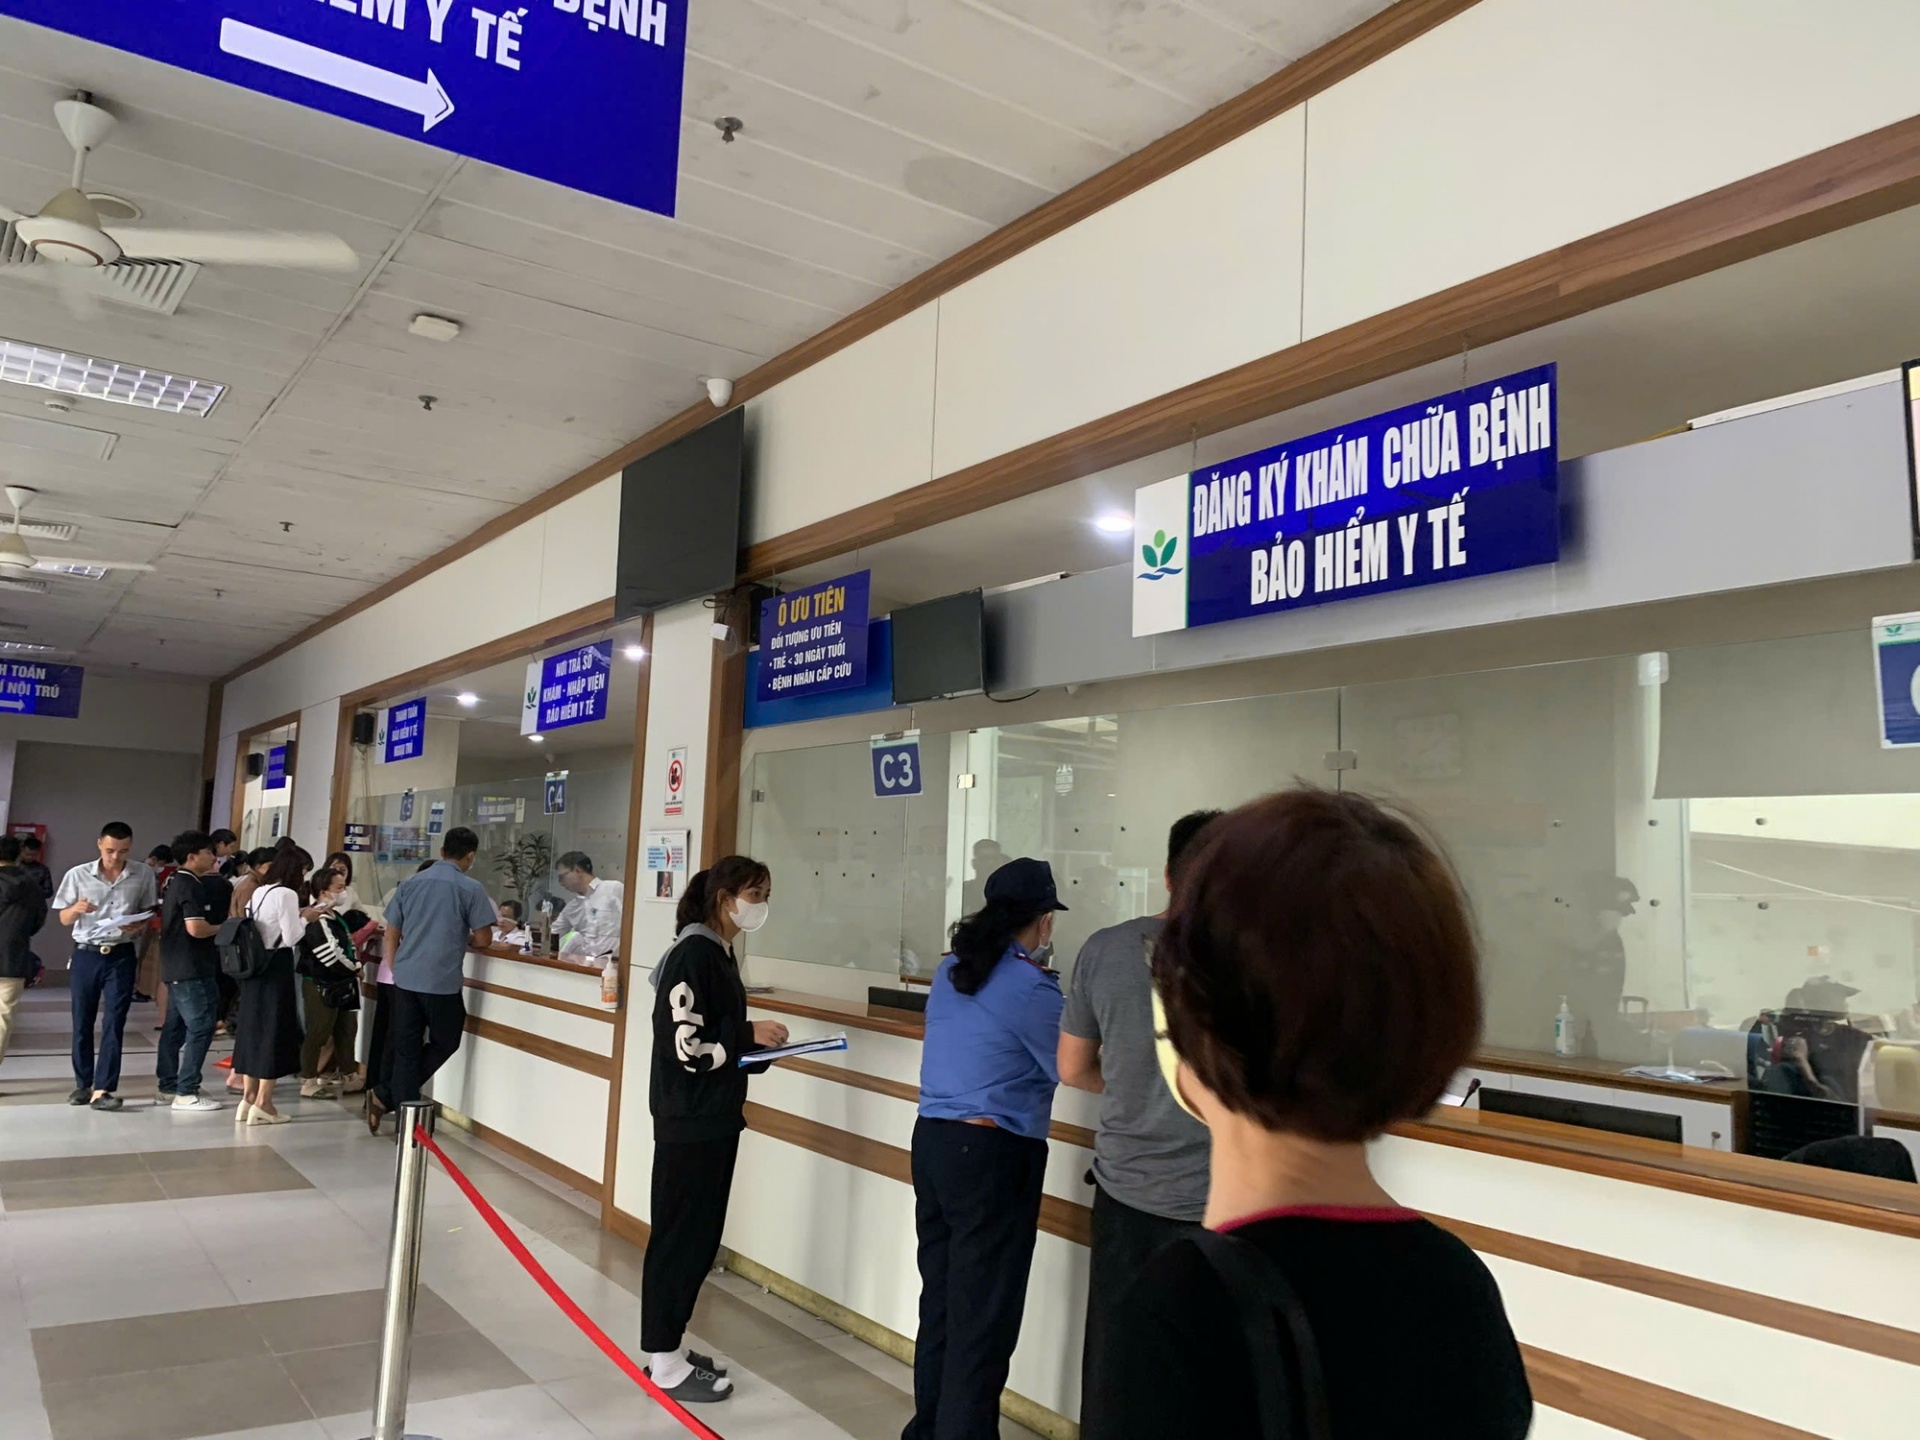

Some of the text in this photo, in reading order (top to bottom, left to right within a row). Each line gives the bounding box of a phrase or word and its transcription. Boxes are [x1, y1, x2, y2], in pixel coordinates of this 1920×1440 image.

[426, 0, 453, 43] Y
[471, 8, 528, 71] TẾ
[1193, 382, 1551, 538] ĐĂNG KÝ KHÁM CHỮA BỆNH
[1250, 487, 1470, 605] BẢO HIỂM Y TẾ
[778, 585, 845, 627] Ô ƯU TIÊN
[771, 620, 842, 650] ĐỐI TƯỢNG ƯU TIÊN
[773, 652, 786, 670] TRẺ
[794, 652, 804, 665] 30
[805, 645, 825, 663] NGÀY
[827, 637, 846, 658] TUỔI
[11, 664, 46, 680] TOÁN
[567, 676, 586, 697] NHẬP
[587, 671, 605, 693] VIỆN
[772, 661, 852, 691] BỆNH NHÂN CẤP CỨU
[7, 681, 31, 697] NỘI
[35, 684, 60, 698] TRÚ
[546, 692, 597, 724] BẢO HIỂM Y TẾ
[880, 752, 913, 788] C3
[548, 784, 563, 809] C4
